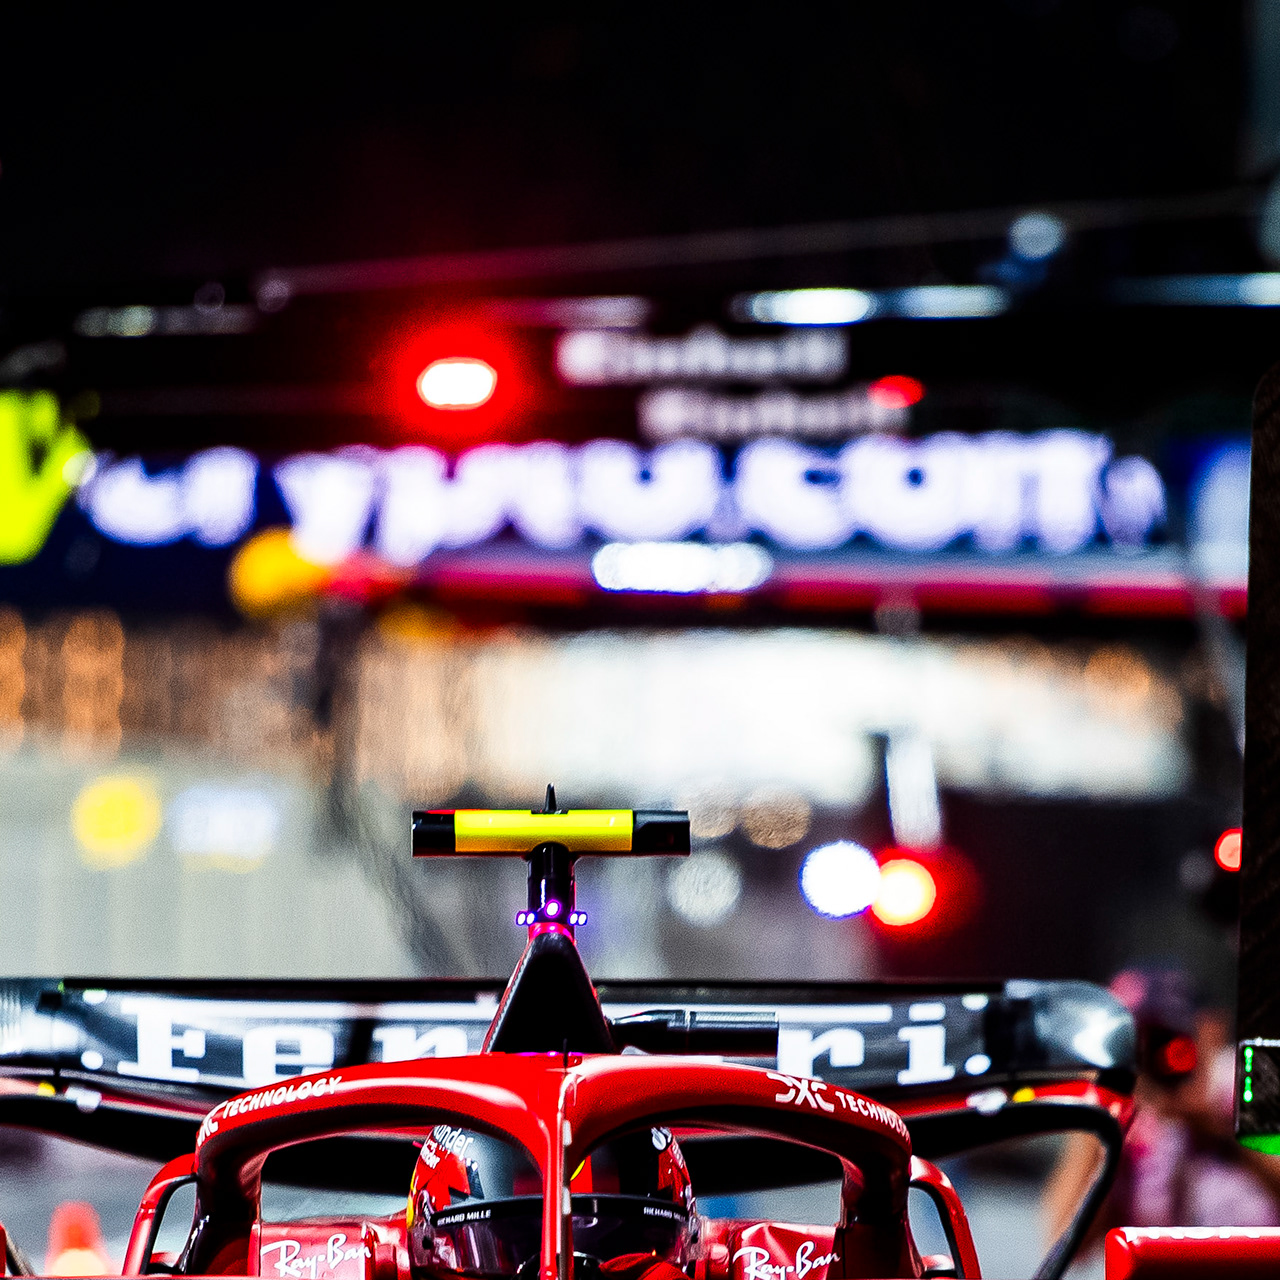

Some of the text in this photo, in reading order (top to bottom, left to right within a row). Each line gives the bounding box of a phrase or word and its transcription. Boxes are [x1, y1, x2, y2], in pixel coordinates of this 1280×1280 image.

[223, 1075, 343, 1119] TECHNOLOGY
[766, 1072, 836, 1114] DXC
[466, 1208, 492, 1221] MILLE
[260, 1232, 372, 1280] Ray-Ban
